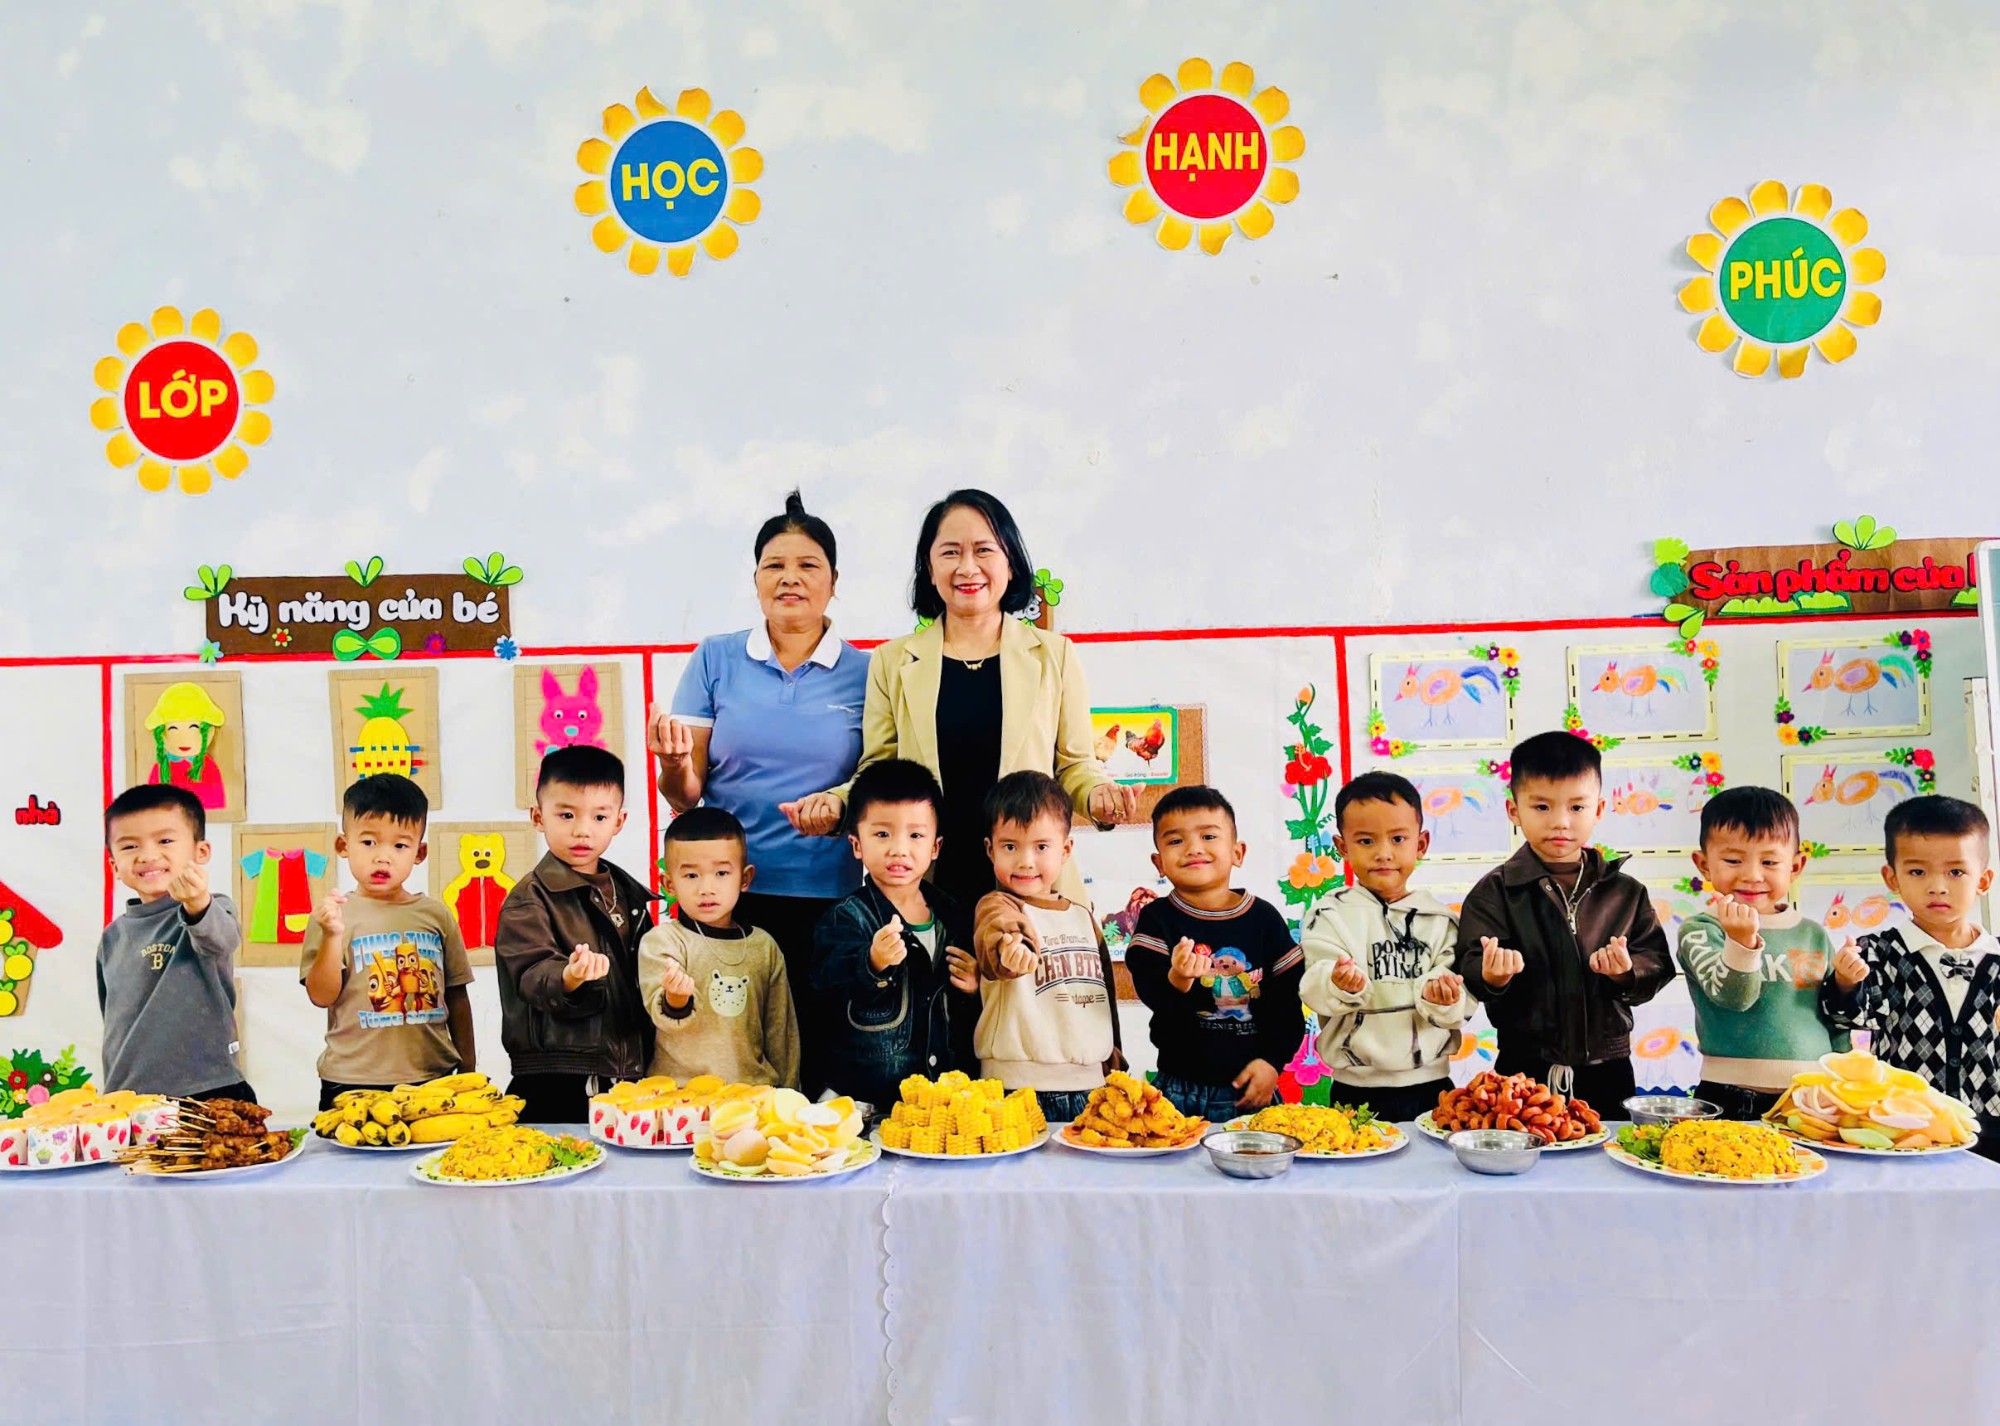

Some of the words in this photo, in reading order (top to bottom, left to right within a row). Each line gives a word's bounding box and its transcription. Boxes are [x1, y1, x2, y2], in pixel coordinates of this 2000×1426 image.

[1154, 132, 1259, 182] HẠNH
[622, 158, 719, 210] HỌC
[1730, 246, 1841, 300] PHÚC
[139, 369, 228, 418] LỚP
[1691, 560, 1773, 600] Sản
[1775, 549, 1890, 602] phẩm
[1892, 556, 1965, 591] của
[218, 591, 269, 634] Kỹ
[278, 591, 370, 631] năng
[378, 588, 443, 622] của
[452, 591, 500, 623] bé
[151, 953, 164, 970] B
